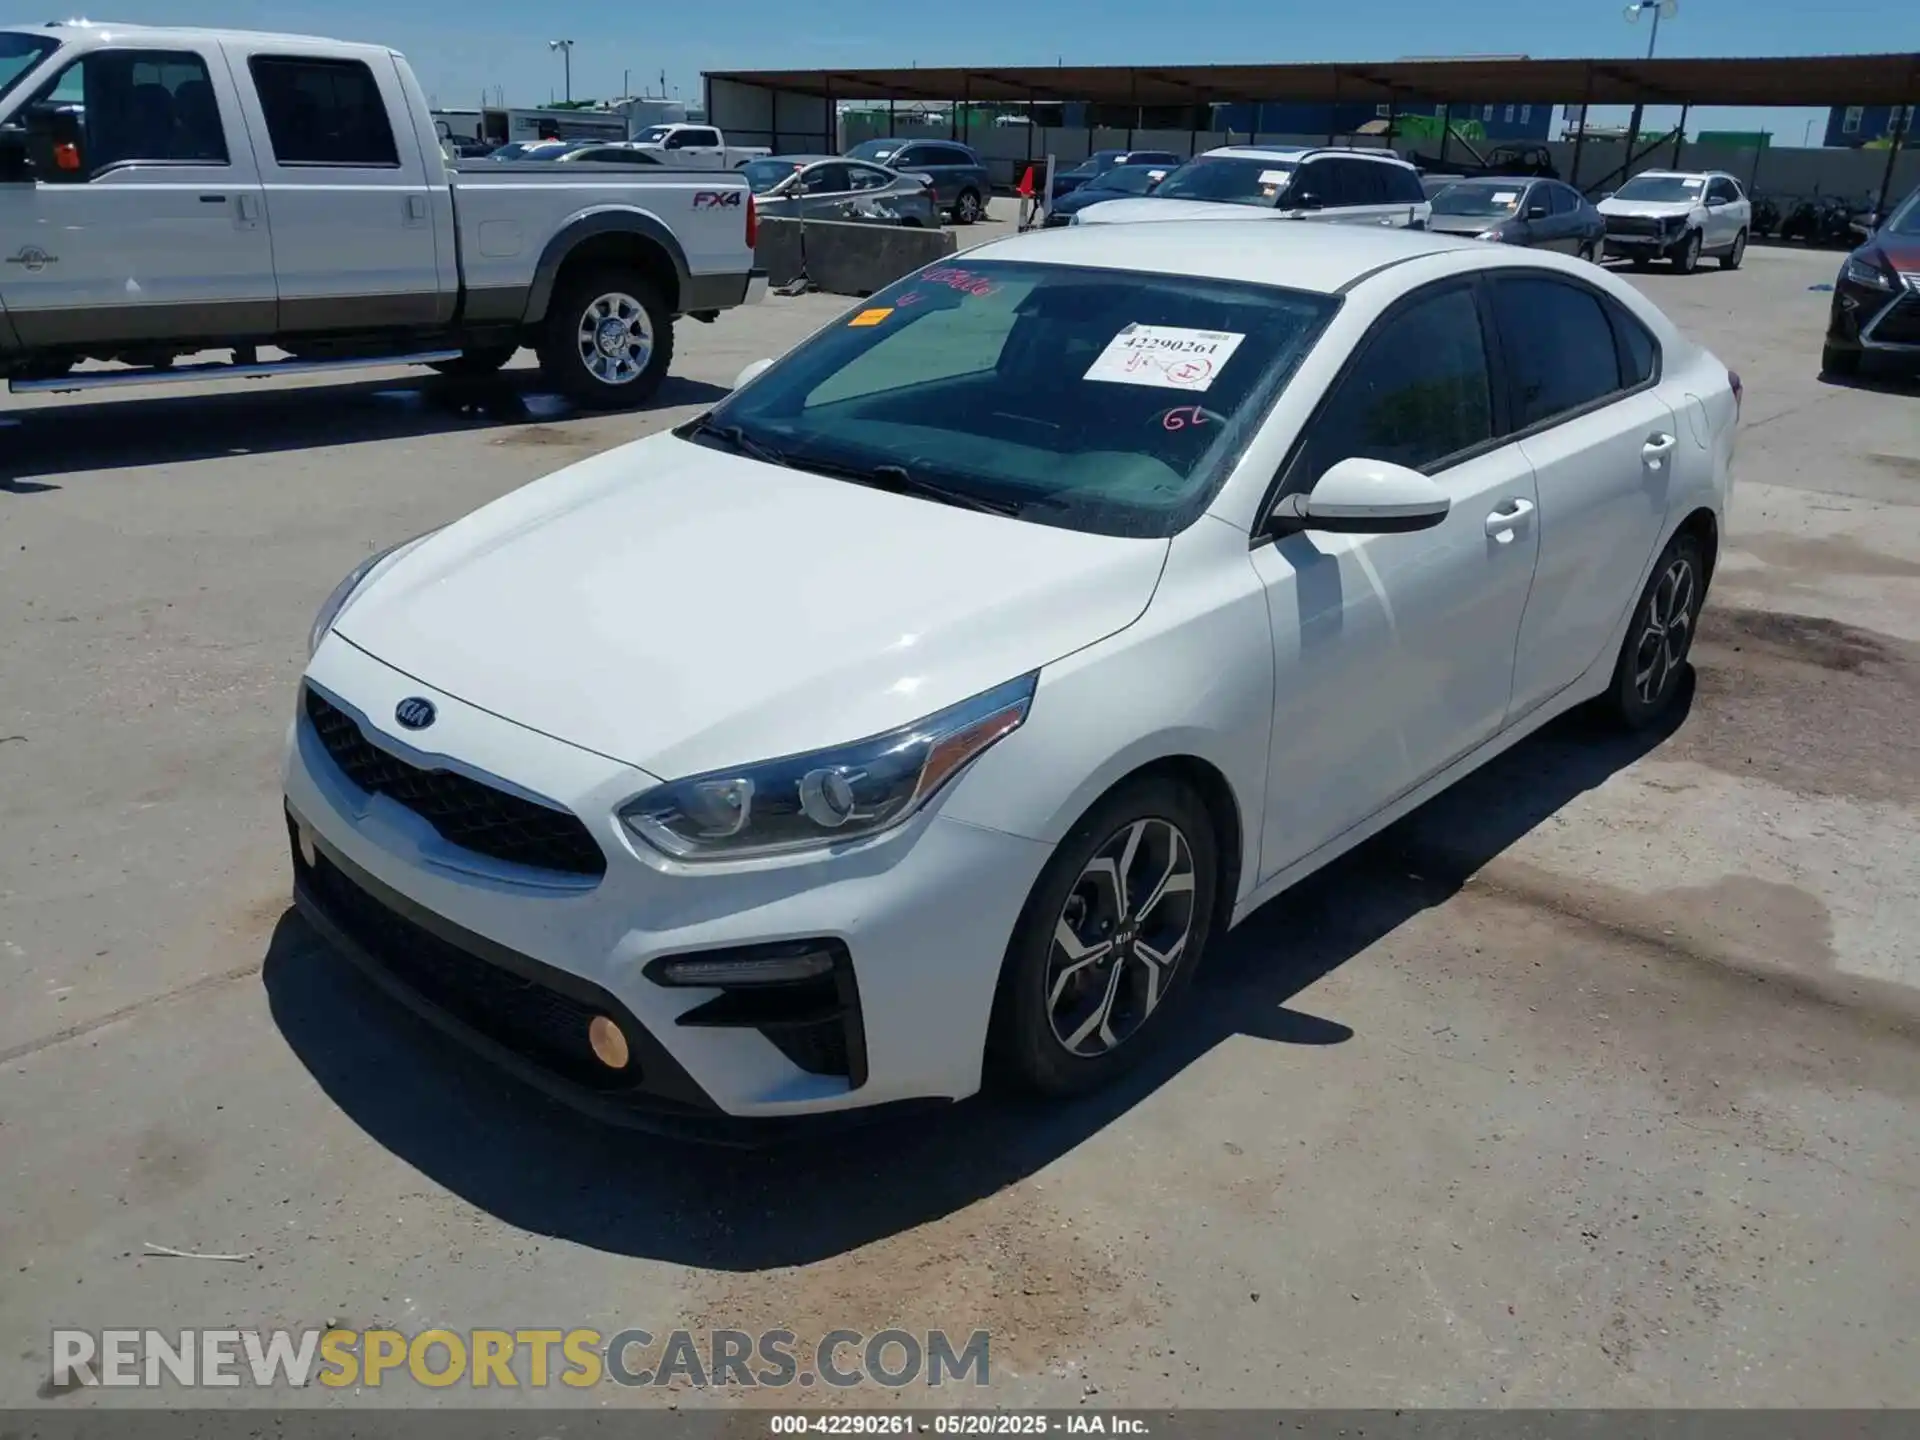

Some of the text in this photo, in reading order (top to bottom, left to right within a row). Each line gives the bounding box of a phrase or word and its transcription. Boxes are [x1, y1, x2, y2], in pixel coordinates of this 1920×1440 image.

[693, 191, 741, 207] FX4
[1124, 337, 1219, 355] 42290261
[398, 699, 431, 726] KIA
